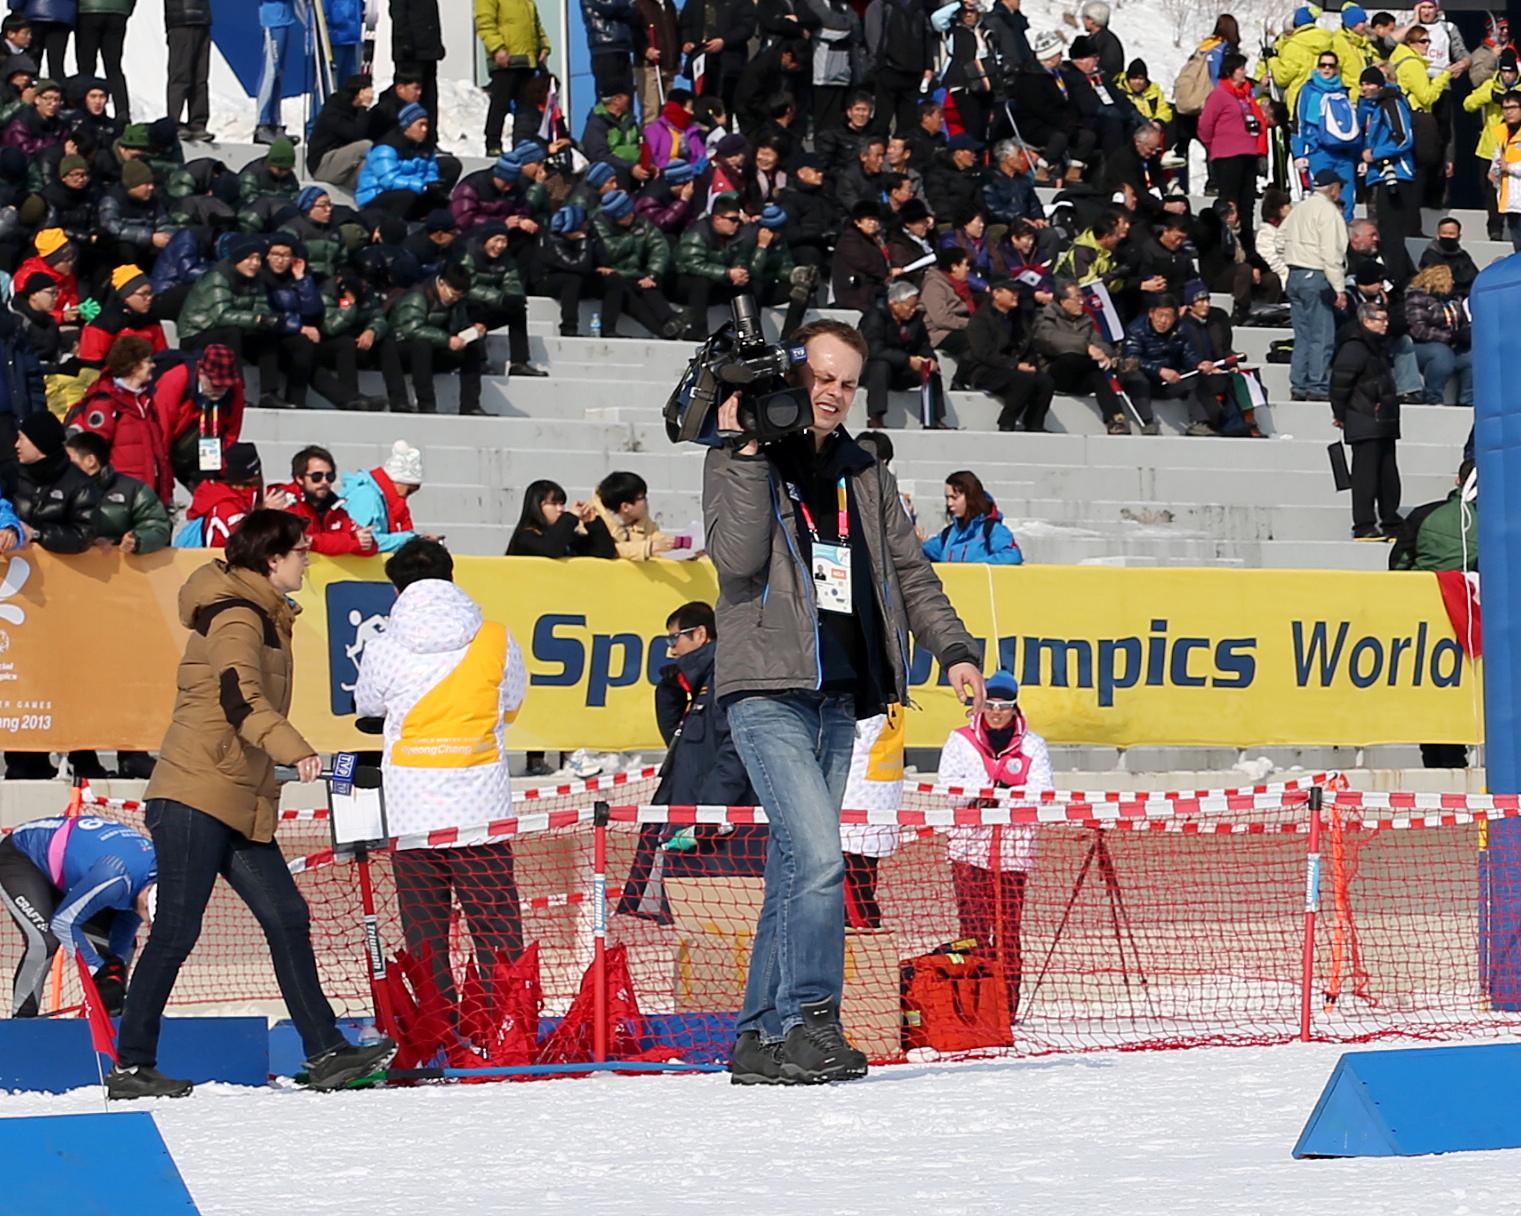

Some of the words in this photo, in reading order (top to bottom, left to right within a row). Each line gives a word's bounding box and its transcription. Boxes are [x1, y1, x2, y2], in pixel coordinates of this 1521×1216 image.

[1291, 620, 1465, 688] World
[21, 714, 52, 730] 2013
[14, 895, 44, 927] CRAFT
